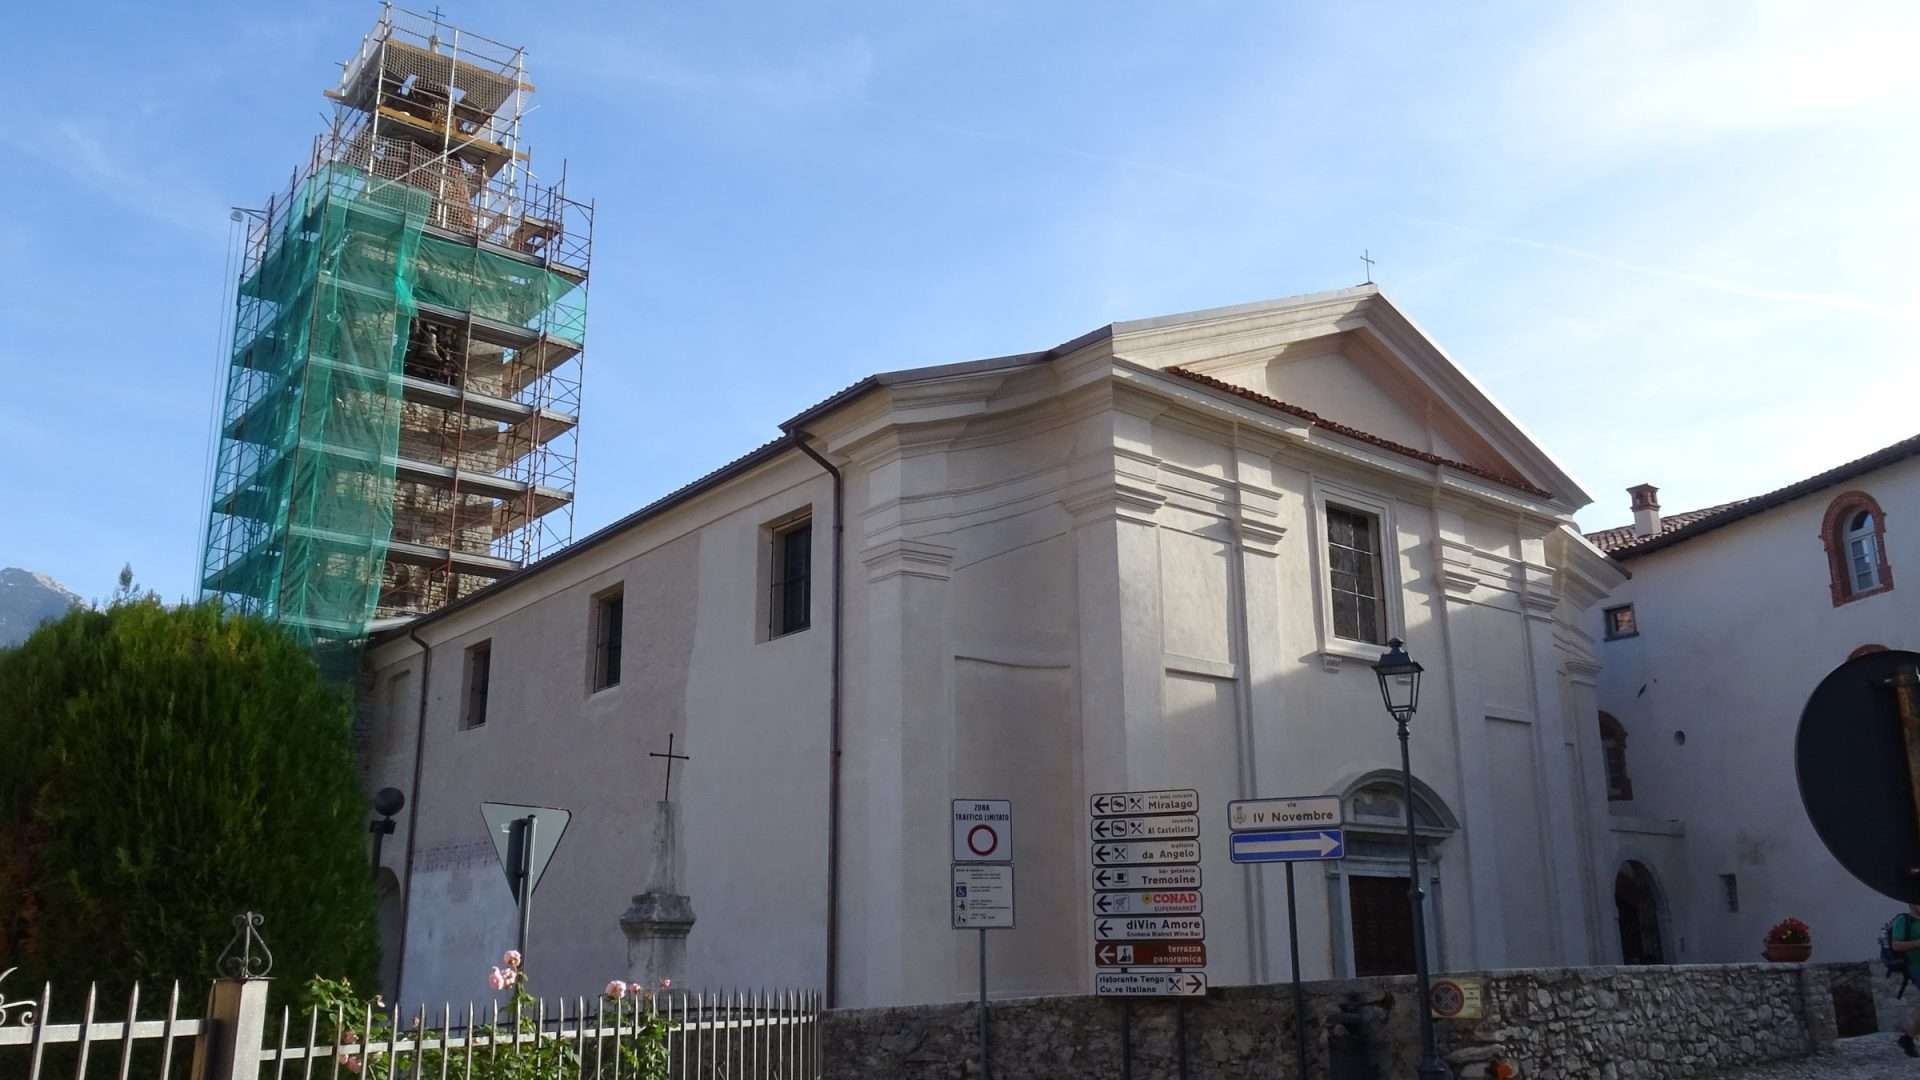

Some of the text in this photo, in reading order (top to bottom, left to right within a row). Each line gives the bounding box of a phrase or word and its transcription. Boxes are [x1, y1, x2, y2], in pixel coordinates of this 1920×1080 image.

[1148, 800, 1192, 809] Miralago
[1254, 810, 1333, 822] IV Novembre
[1142, 849, 1194, 859] da Angelo
[1141, 875, 1195, 884] Tremosine
[1153, 894, 1196, 903] CONAD
[1162, 920, 1200, 929] Amore
[1153, 955, 1202, 964] panoramica
[1140, 976, 1164, 984] Tengo
